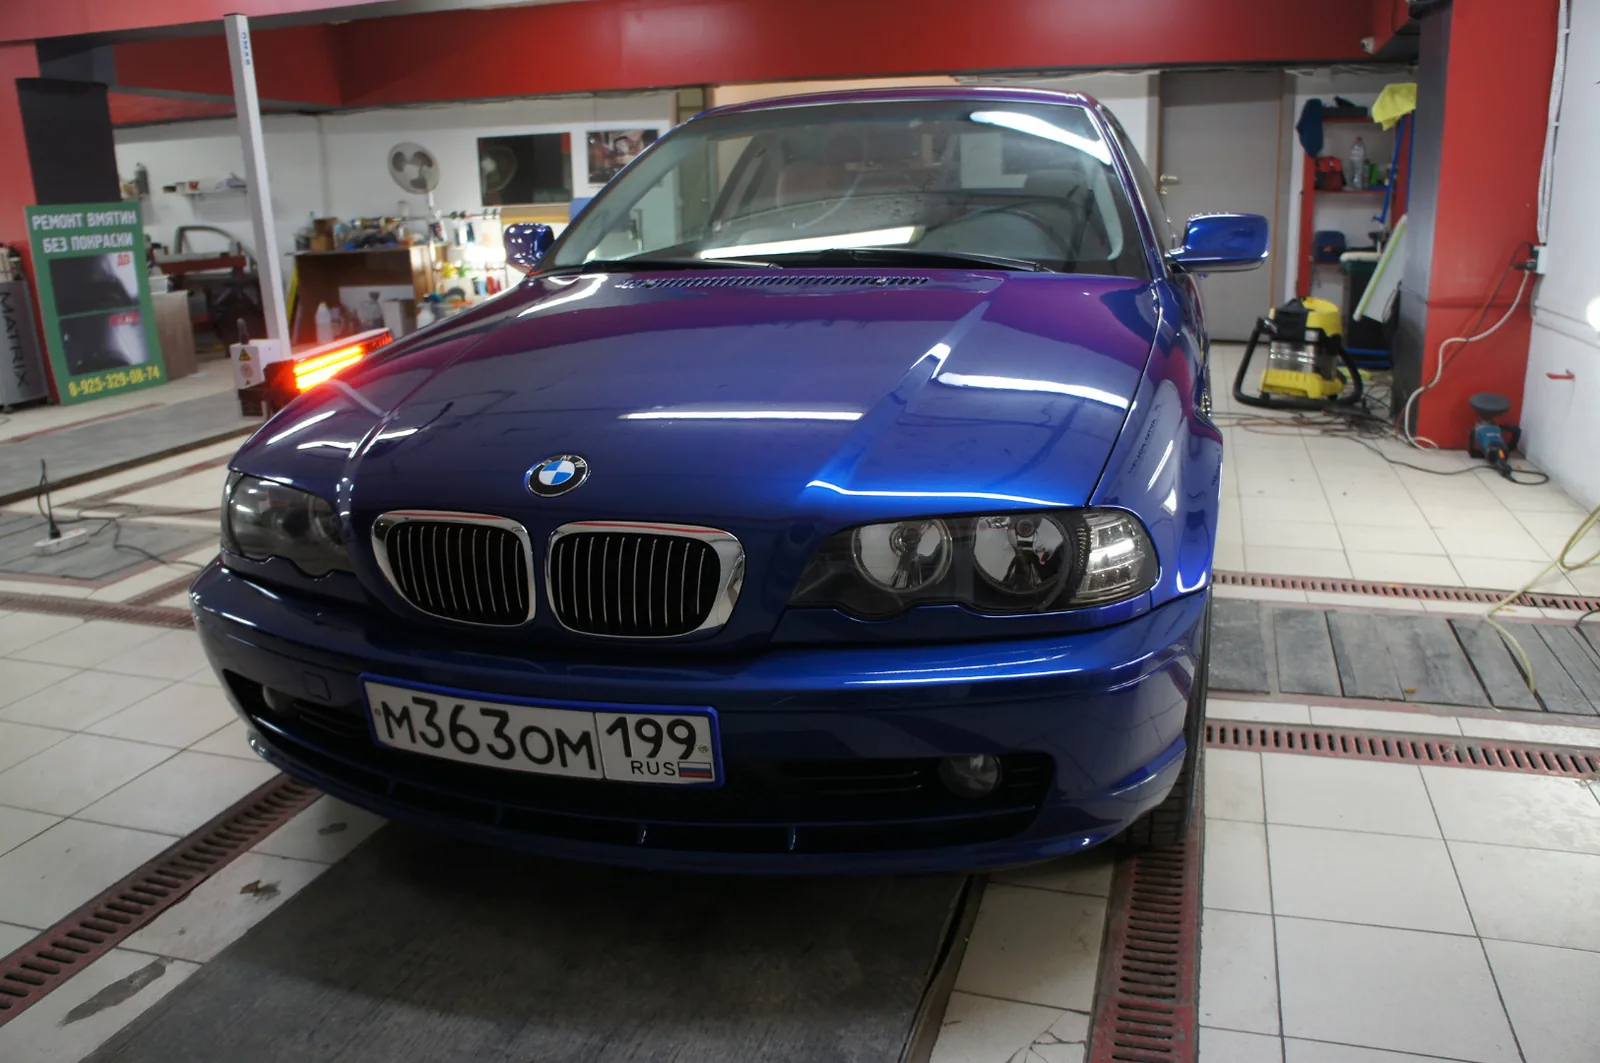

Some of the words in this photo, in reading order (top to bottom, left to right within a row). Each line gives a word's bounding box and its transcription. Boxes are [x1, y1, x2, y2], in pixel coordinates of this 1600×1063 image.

[32, 212, 84, 231] РЕМОНТ
[86, 209, 137, 228] ВМЯТИН
[42, 236, 67, 253] БЕЗ
[70, 232, 134, 251] ПОКРАСКИ
[0, 291, 29, 389] MATRIX
[605, 716, 697, 761] 199
[630, 760, 676, 777] RUS
